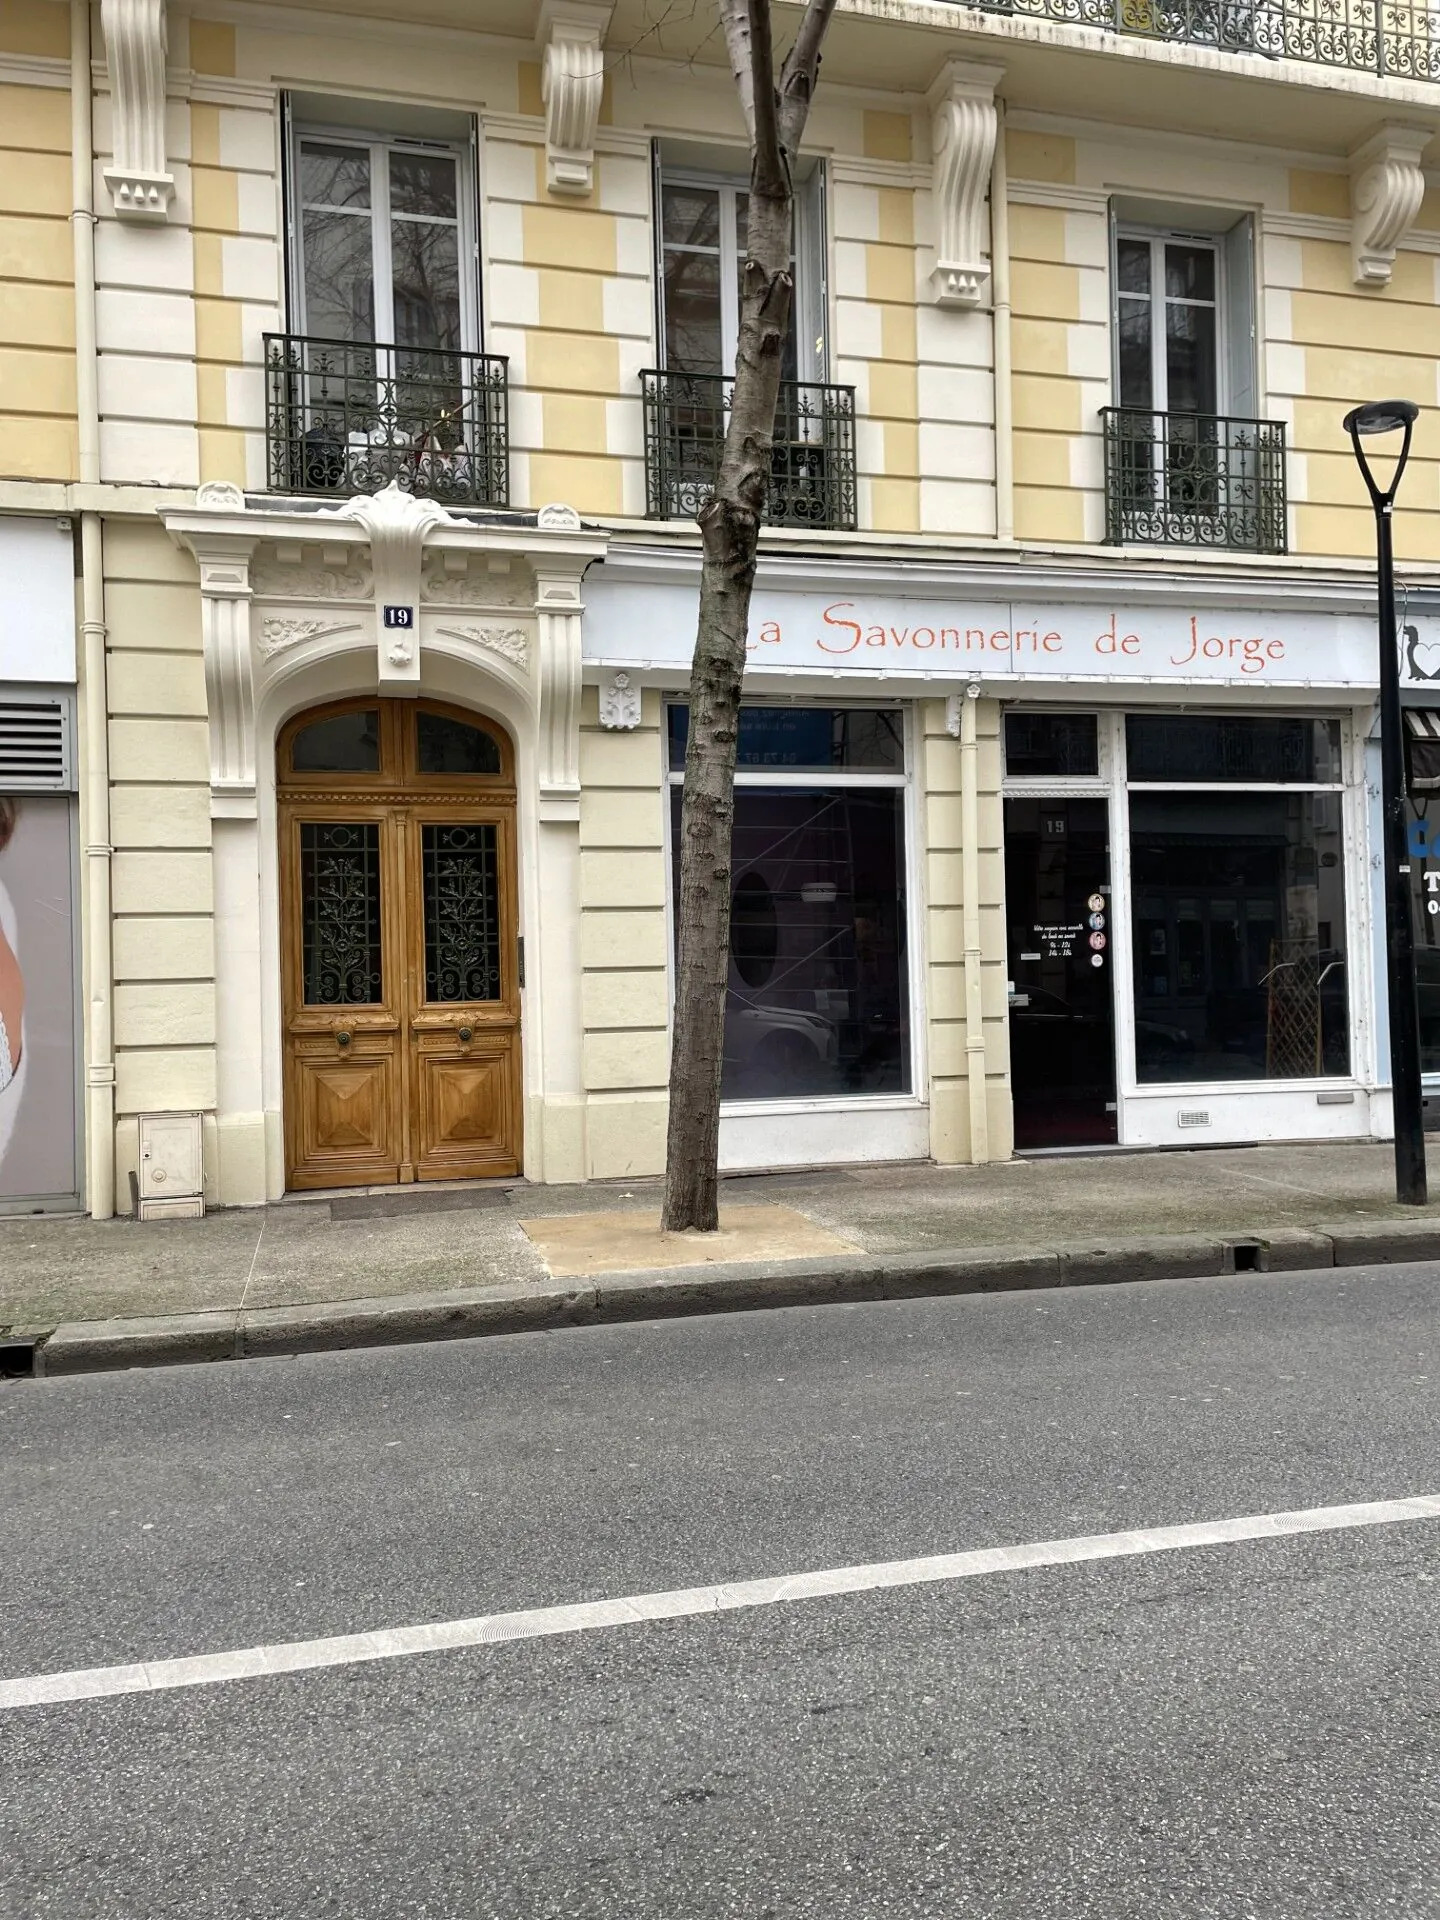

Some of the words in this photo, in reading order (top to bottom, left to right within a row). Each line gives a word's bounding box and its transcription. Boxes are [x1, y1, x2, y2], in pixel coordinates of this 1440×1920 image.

[389, 609, 408, 625] 19
[745, 621, 781, 650] a
[816, 602, 1063, 652] Savonnerie
[1095, 613, 1141, 654] de
[1170, 615, 1285, 673] Jorge
[1047, 820, 1065, 833] 19
